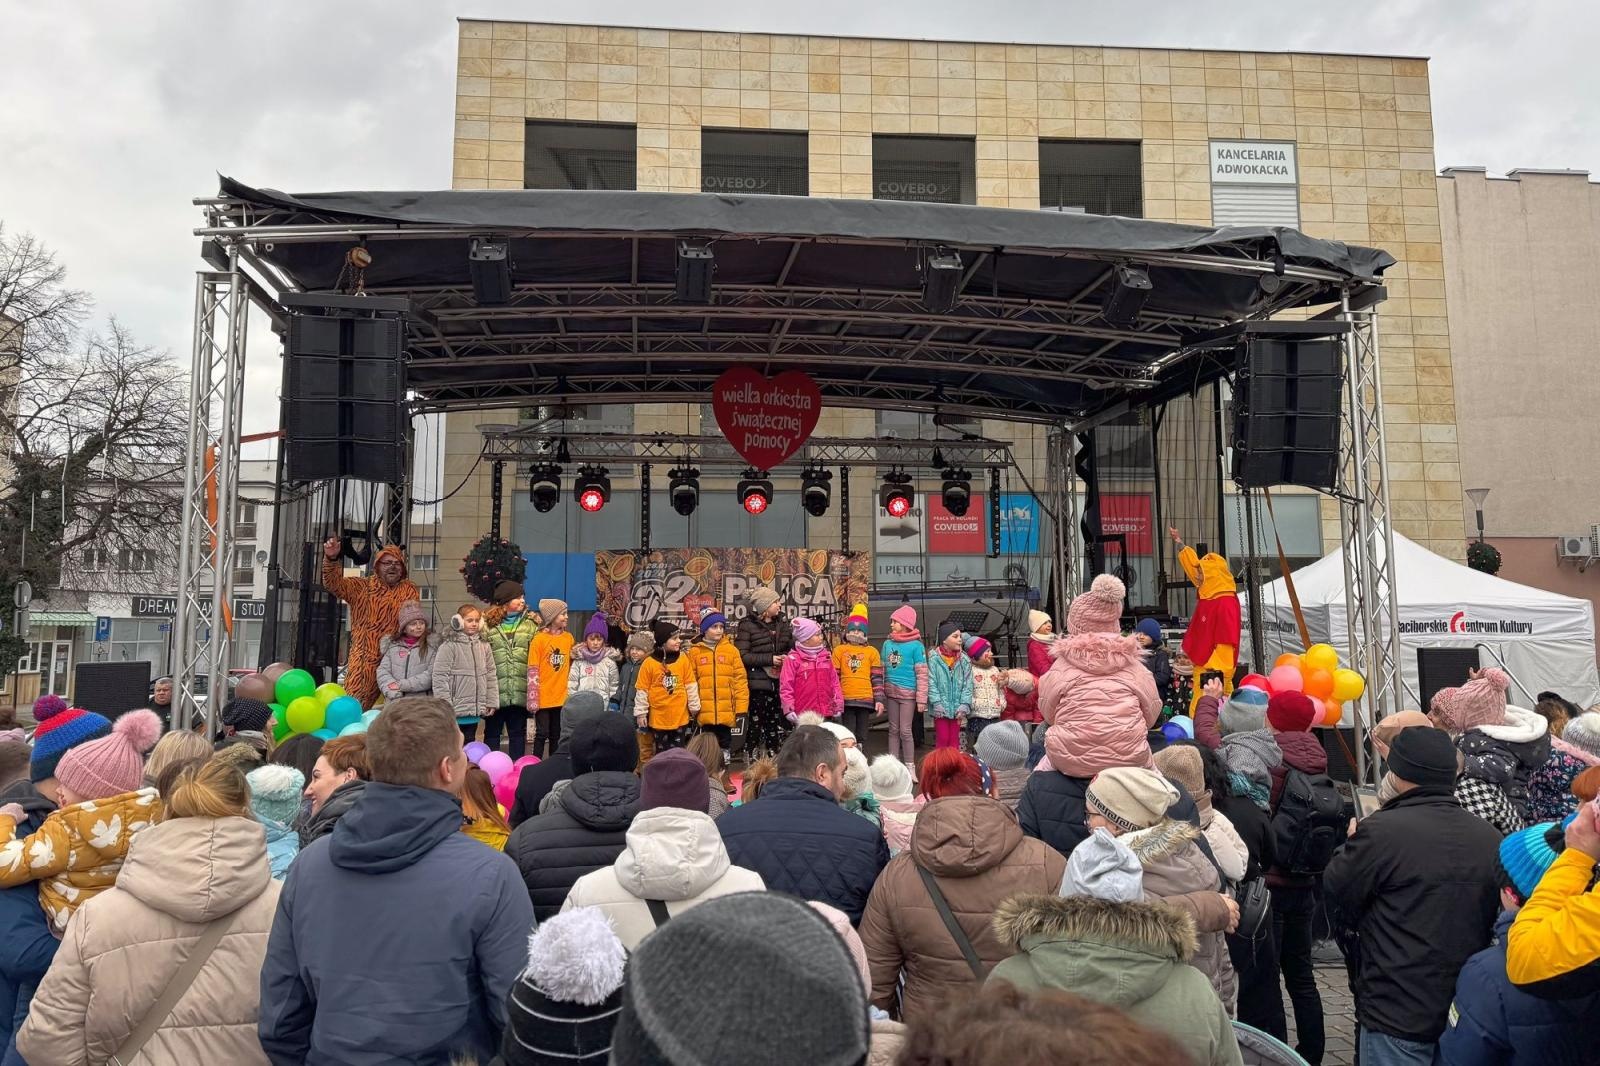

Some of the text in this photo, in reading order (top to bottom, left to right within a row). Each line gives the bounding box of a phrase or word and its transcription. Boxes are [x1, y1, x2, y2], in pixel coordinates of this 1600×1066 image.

[1217, 149, 1286, 161] KANCELARIA
[1216, 164, 1289, 175] ADWOKACKA
[702, 175, 757, 189] OVEBO
[878, 182, 937, 194] COVEBO
[722, 382, 812, 409] wielka orkiestra
[743, 431, 791, 456] pomocy
[934, 523, 970, 531] COVEBO
[1101, 523, 1137, 532] COVEBO
[886, 565, 923, 576] PIĘTRO
[627, 571, 699, 625] 32
[139, 599, 178, 613] DREAM
[241, 602, 265, 616] STUD
[724, 604, 747, 620] PO
[99, 619, 108, 633] P
[1499, 619, 1533, 634] Kultury
